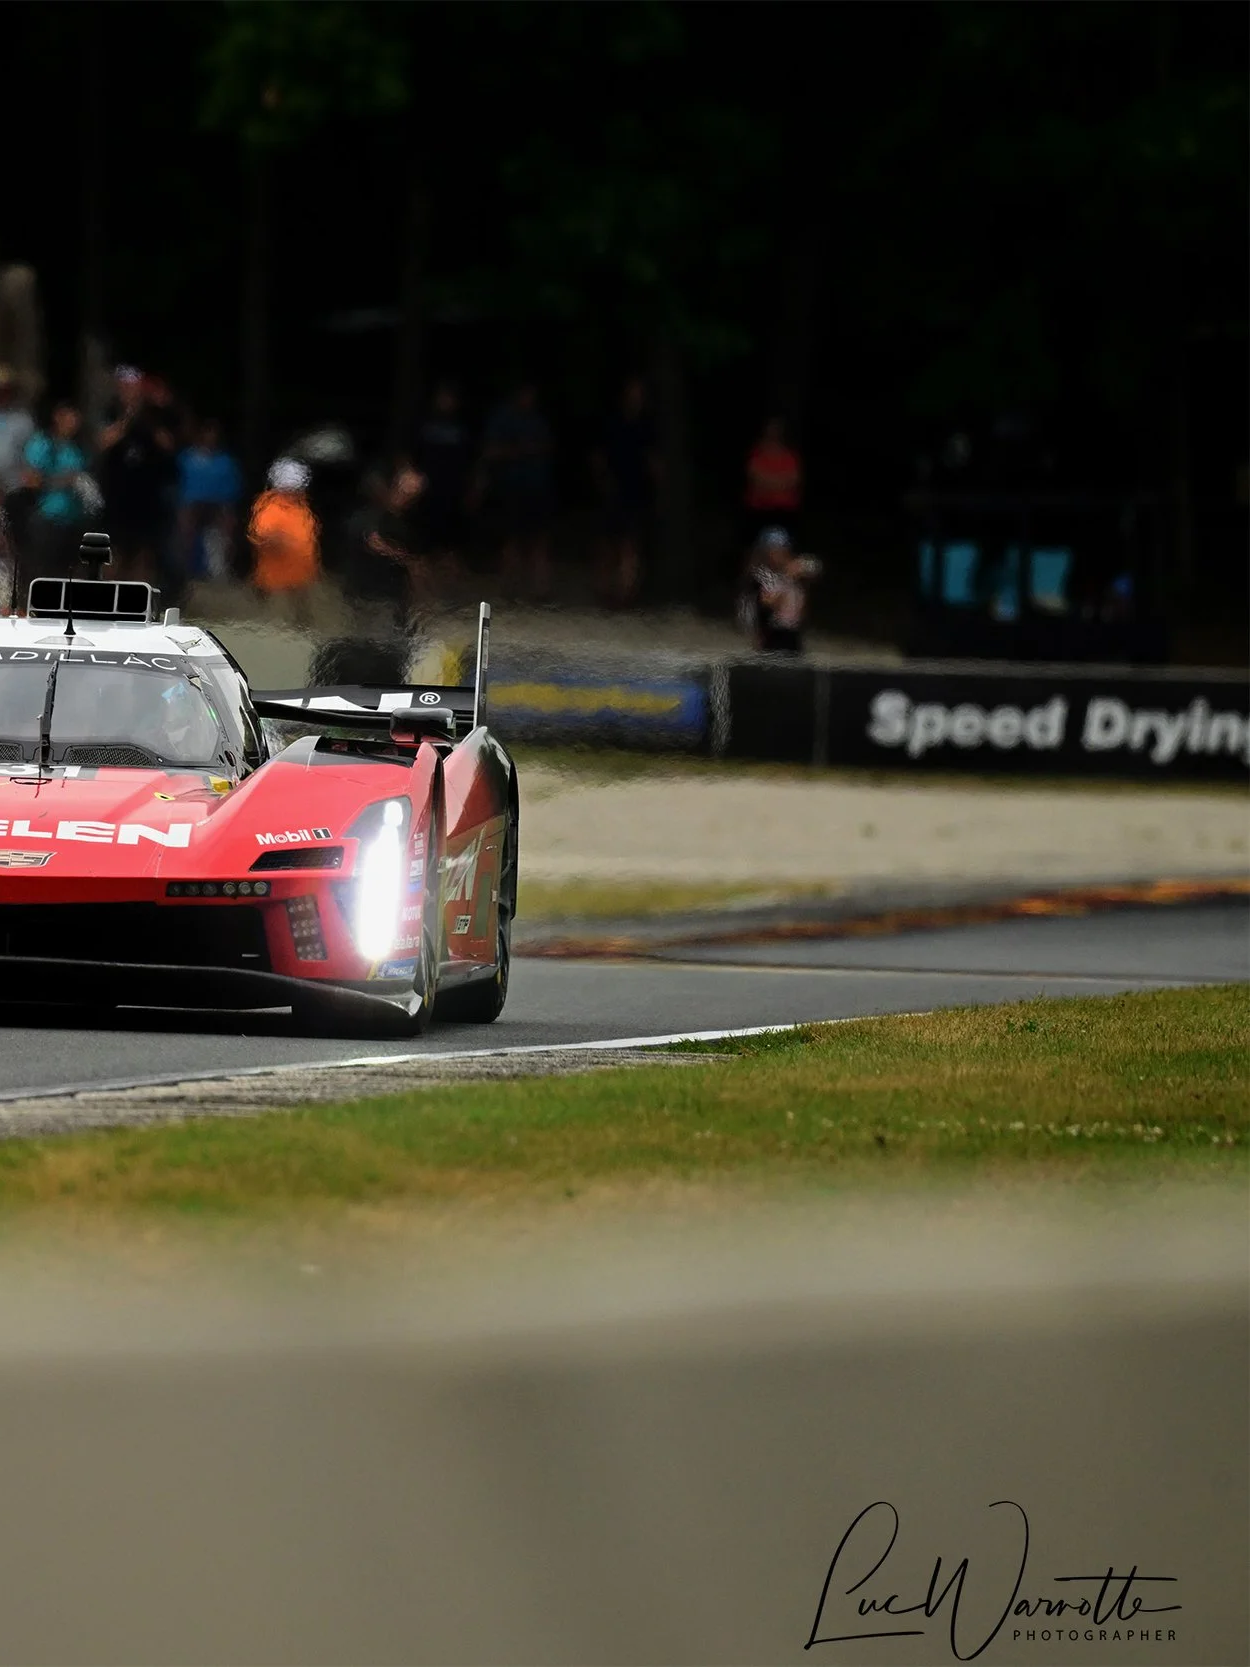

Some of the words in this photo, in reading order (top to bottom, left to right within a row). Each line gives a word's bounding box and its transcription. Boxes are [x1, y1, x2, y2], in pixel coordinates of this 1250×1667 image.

[867, 690, 1067, 757] Speed
[1082, 695, 1250, 765] Dryin
[255, 829, 312, 846] Mobil
